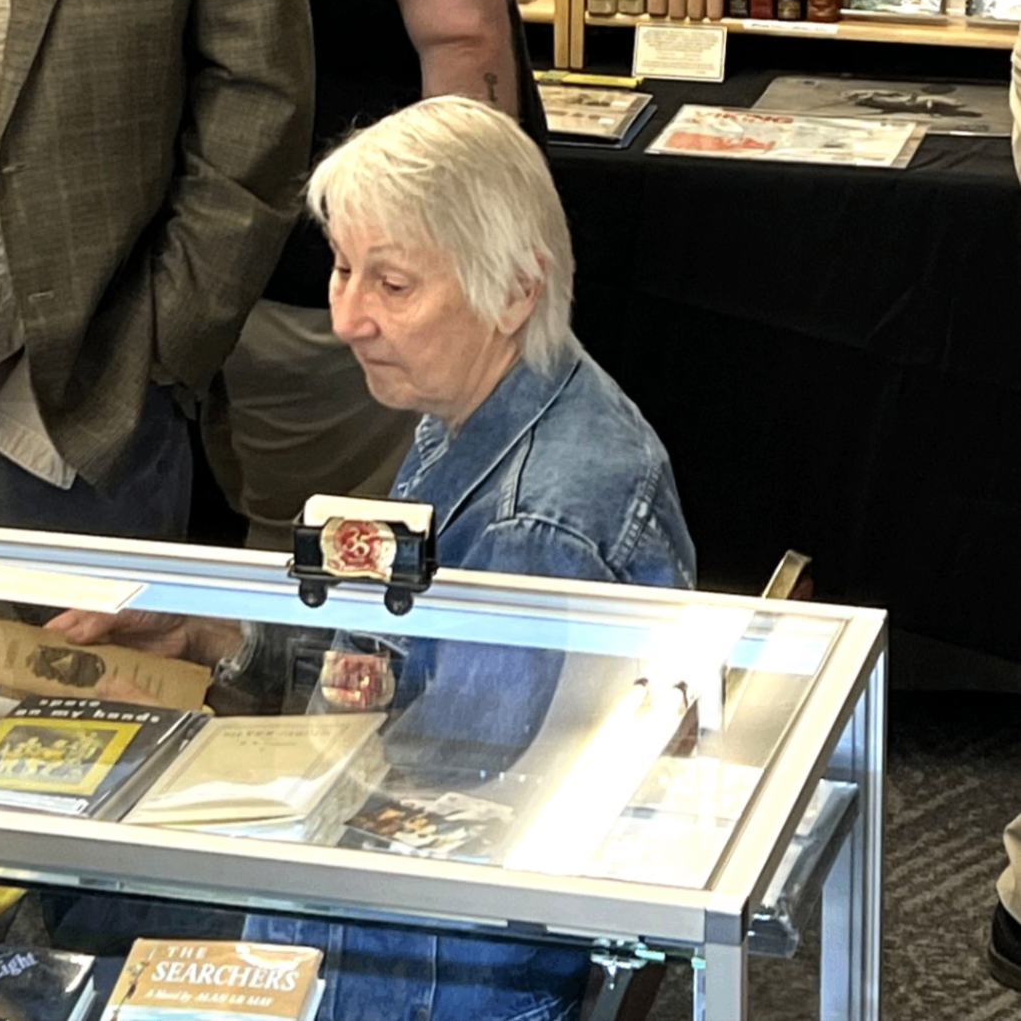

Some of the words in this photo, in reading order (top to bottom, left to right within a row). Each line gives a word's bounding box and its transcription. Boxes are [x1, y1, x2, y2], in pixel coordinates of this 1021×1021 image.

[51, 709, 84, 719] my
[94, 709, 160, 723] hands
[167, 945, 208, 959] THE
[151, 961, 300, 992] SEARCHERS
[145, 989, 155, 998] A
[155, 989, 181, 1000] Novel
[181, 991, 193, 1003] by
[196, 991, 227, 1003] ALAN
[246, 994, 273, 1007] MAY
